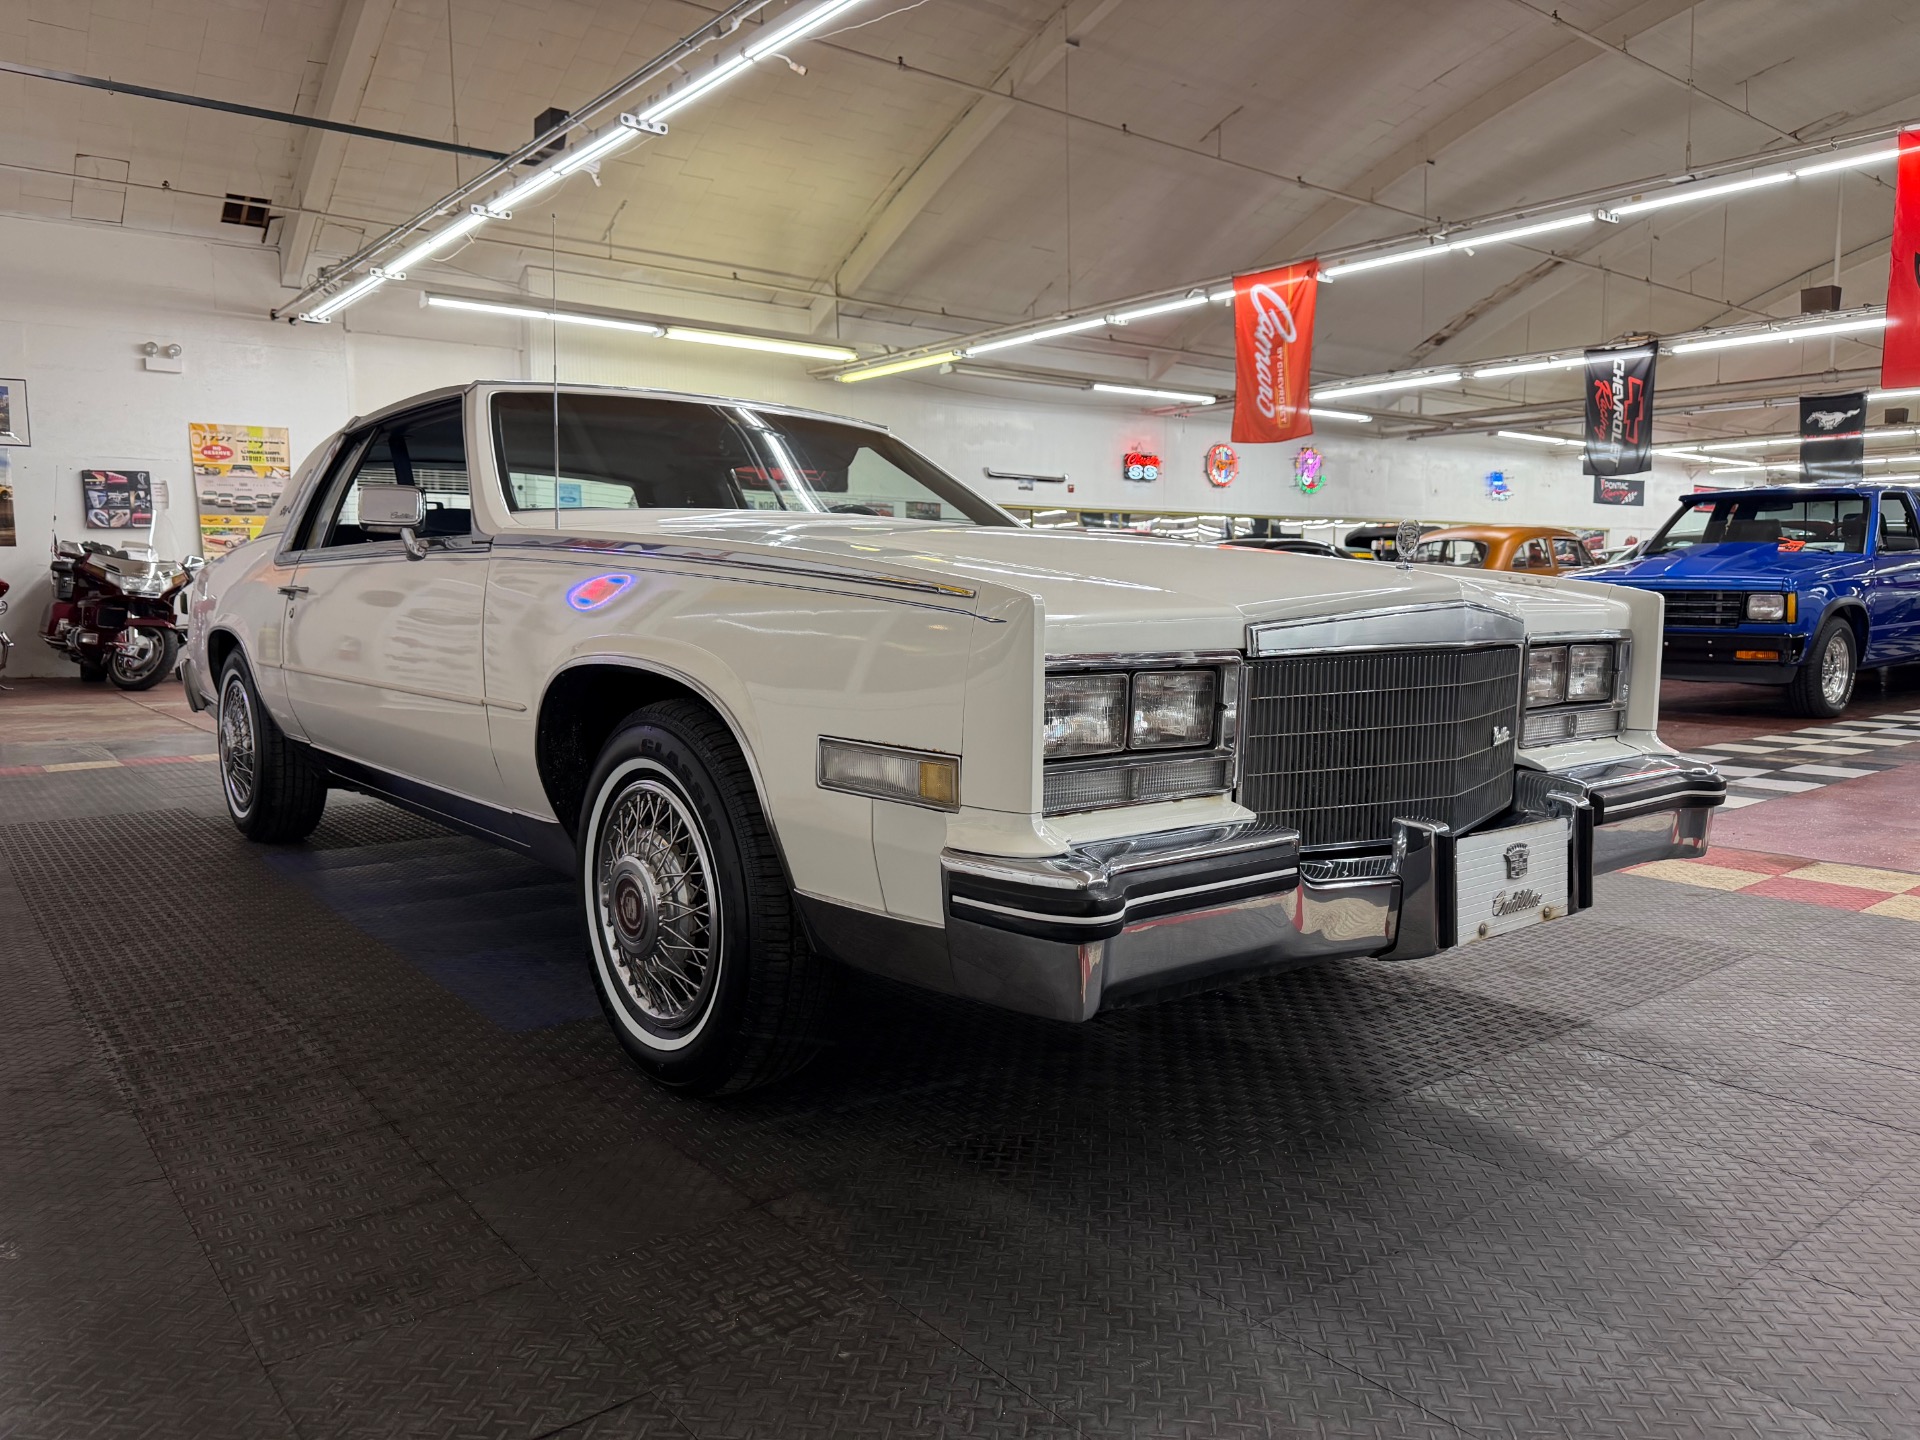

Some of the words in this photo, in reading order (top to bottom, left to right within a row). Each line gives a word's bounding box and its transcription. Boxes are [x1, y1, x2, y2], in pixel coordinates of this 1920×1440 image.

[1250, 283, 1297, 419] Camaro
[1276, 346, 1284, 360] BY
[1276, 361, 1288, 424] CHEVROLET
[1594, 379, 1614, 441] Racing
[1611, 358, 1625, 469] CHEVROLET
[1128, 465, 1158, 480] SS
[640, 738, 722, 841] CLASSIC
[1492, 890, 1543, 916] Cadillac
